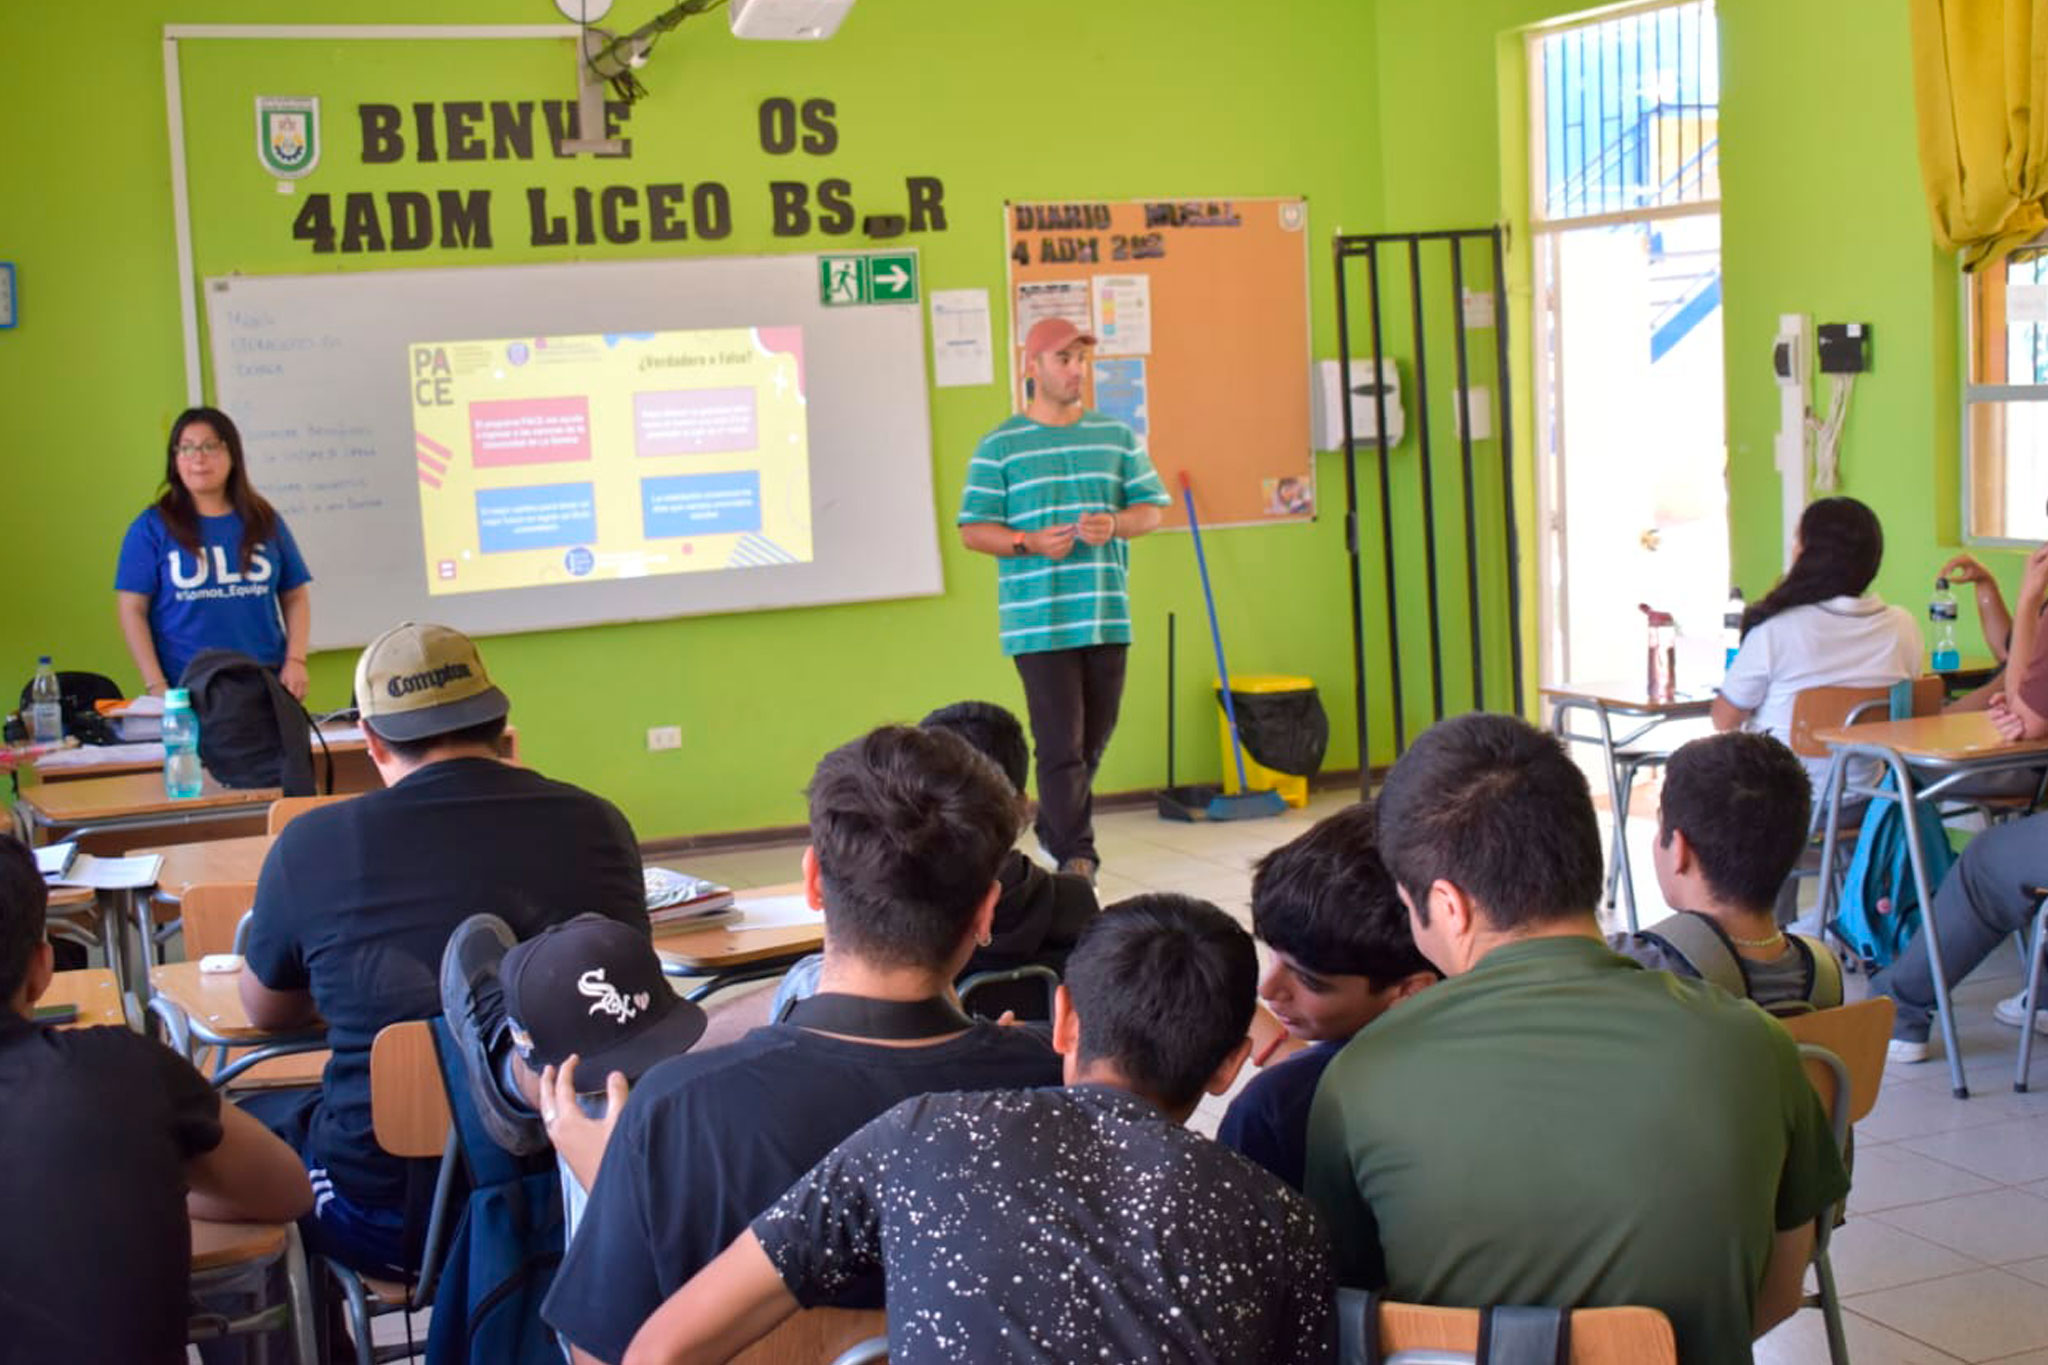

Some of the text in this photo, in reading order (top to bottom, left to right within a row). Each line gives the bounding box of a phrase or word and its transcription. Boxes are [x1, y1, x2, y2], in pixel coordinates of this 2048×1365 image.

[759, 97, 839, 156] OS
[293, 189, 494, 253] 4ADM
[526, 182, 732, 247] LICEO
[1016, 204, 1111, 231] DIARIO
[1012, 240, 1029, 265] 4
[1040, 237, 1098, 263] ADM
[168, 543, 272, 589] ULS
[577, 967, 637, 1024] Sox
